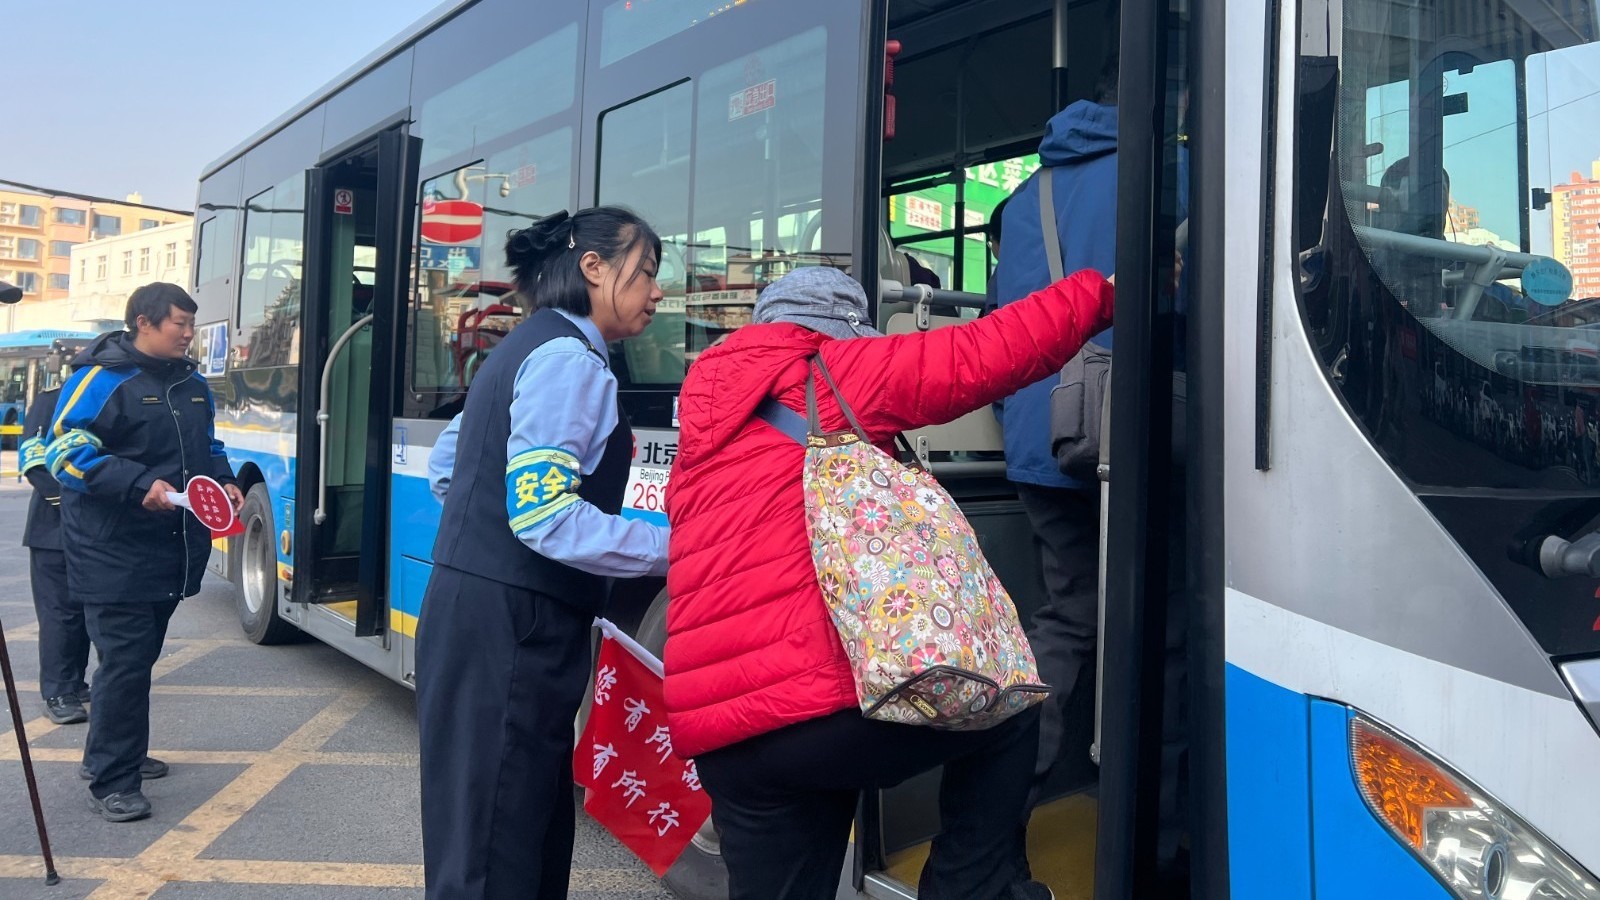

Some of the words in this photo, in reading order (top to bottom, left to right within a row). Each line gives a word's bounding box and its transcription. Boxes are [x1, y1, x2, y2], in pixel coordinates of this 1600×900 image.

[642, 442, 679, 465] 北京
[516, 466, 580, 508] 安全
[640, 468, 663, 484] Beijing
